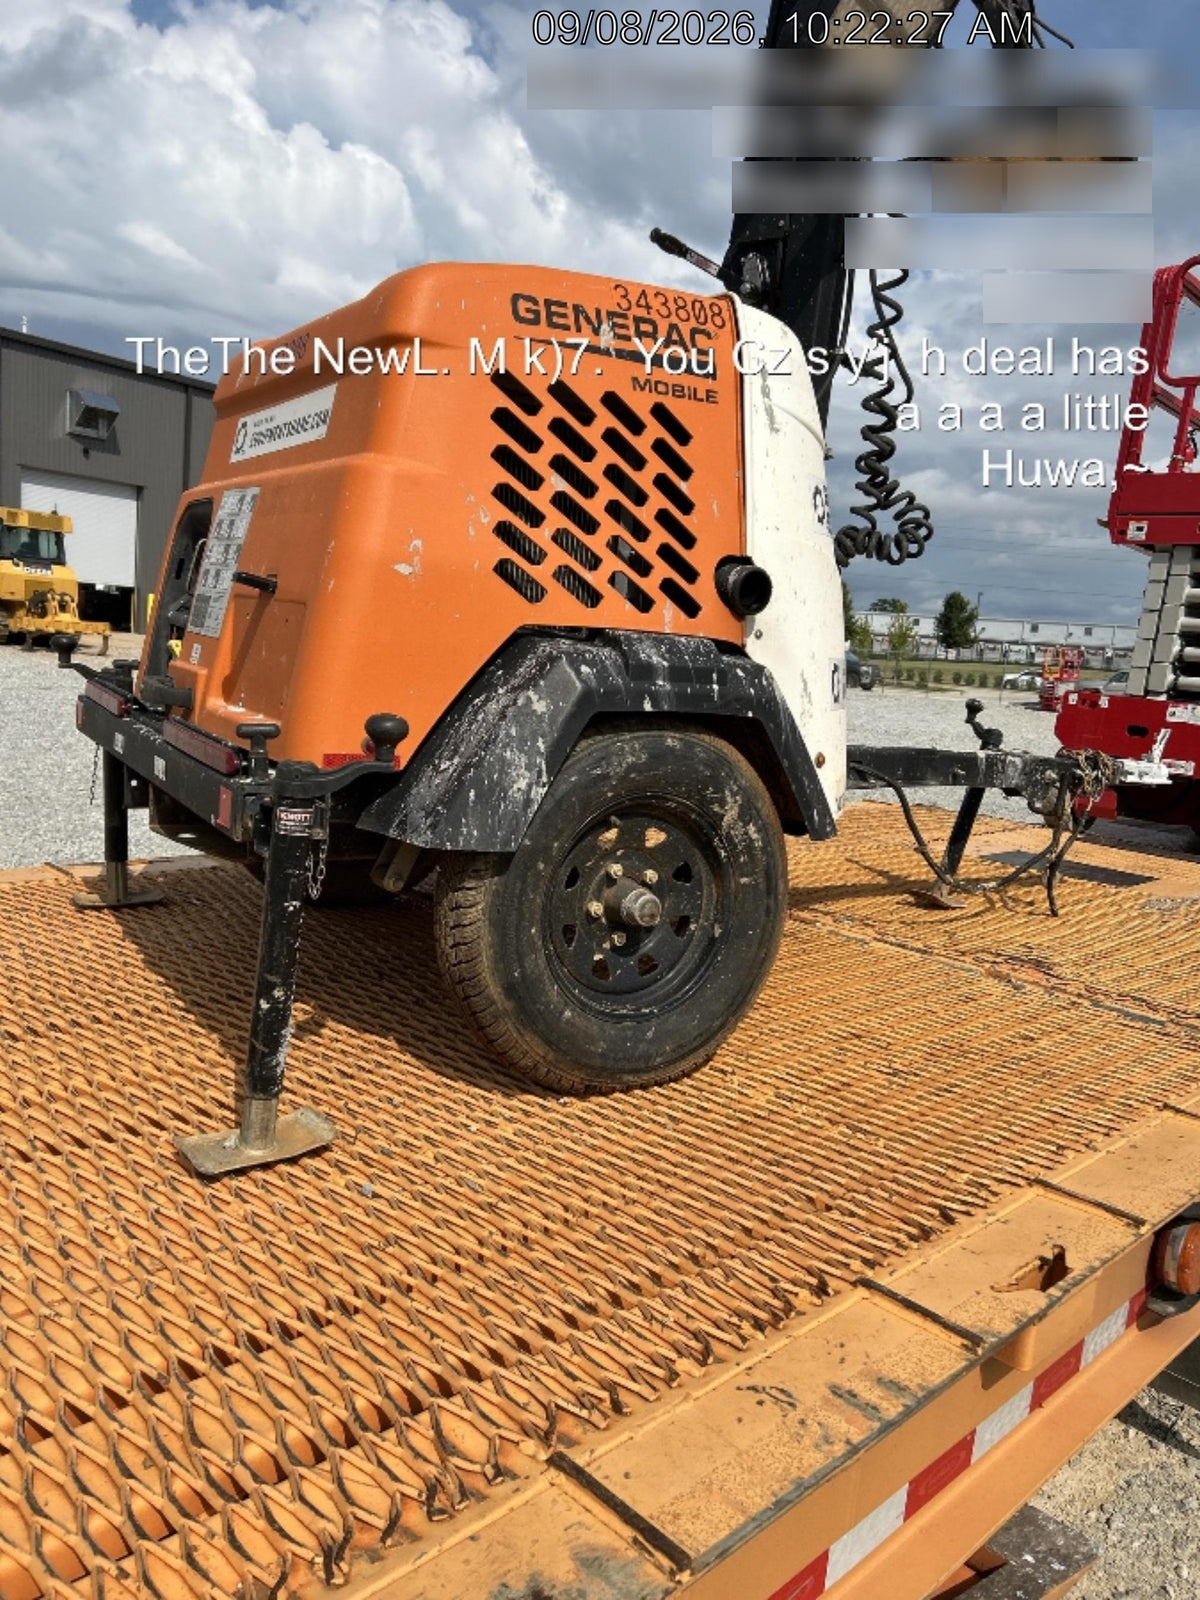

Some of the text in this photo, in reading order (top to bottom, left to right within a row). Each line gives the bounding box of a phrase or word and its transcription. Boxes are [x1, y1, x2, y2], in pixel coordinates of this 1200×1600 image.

[510, 293, 714, 356] GENERAC
[614, 284, 726, 329] 343808
[631, 376, 719, 404] MOBILE
